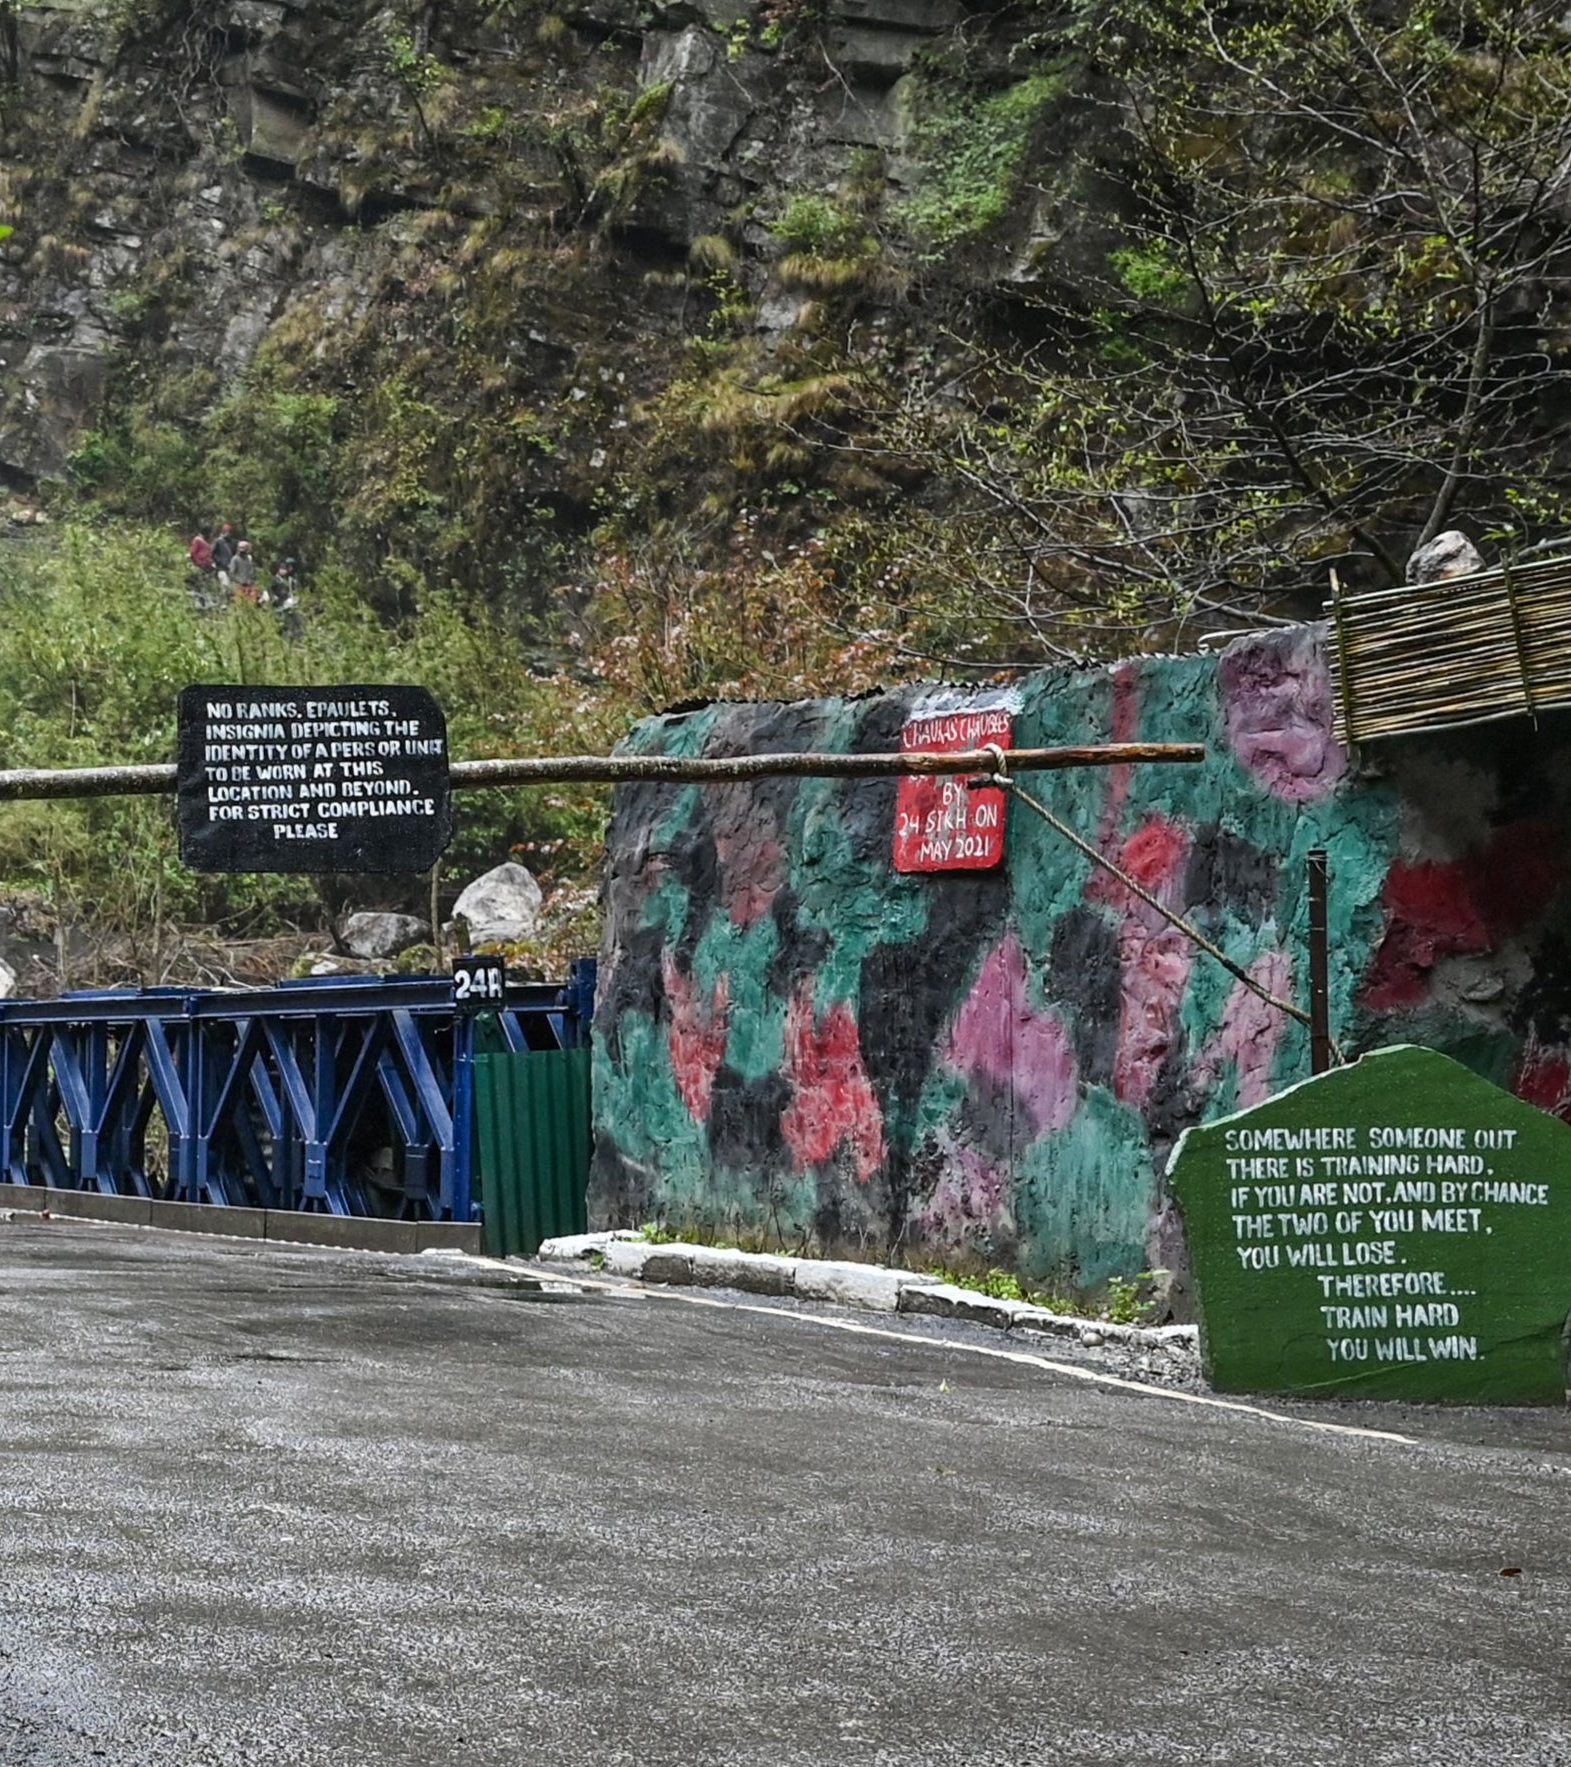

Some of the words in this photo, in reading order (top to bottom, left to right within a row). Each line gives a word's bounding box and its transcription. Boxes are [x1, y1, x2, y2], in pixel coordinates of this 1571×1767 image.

[207, 703, 232, 719] NO
[206, 724, 285, 740] INSIGNIA
[291, 722, 380, 738] DEPICTING
[384, 720, 419, 736] THE
[205, 744, 288, 761] IDENTITY
[292, 744, 308, 759] OF
[315, 743, 329, 759] A
[331, 742, 375, 758] PERS
[378, 741, 401, 757] OR
[206, 766, 228, 782] TO
[232, 766, 250, 781] BE
[257, 764, 306, 780] WORN
[313, 762, 333, 778] AT
[340, 761, 383, 776] THIS
[208, 785, 292, 802] LOCATION
[299, 783, 335, 798] AND
[342, 780, 419, 797] BEYOND.
[943, 782, 962, 805] BY
[209, 806, 244, 821] FOR
[247, 802, 310, 819] STRICT
[317, 799, 434, 816] COMPLIANCE
[899, 813, 919, 836] 24
[926, 807, 967, 833] SIKH
[976, 805, 997, 827] ON
[274, 822, 338, 839] PLEASE
[920, 840, 952, 862] MAY
[957, 838, 989, 857] 2021
[1225, 1128, 1356, 1151] SOMEWHERE
[1369, 1128, 1465, 1149] SOMEONE
[1474, 1129, 1517, 1149] OUT
[1226, 1158, 1289, 1180] THERE
[1296, 1158, 1314, 1178] IS
[1320, 1155, 1420, 1177] TRAINING
[1231, 1186, 1253, 1208] IF
[1255, 1186, 1295, 1207] YOU
[1299, 1184, 1338, 1206] ARE
[1442, 1182, 1465, 1203] BY
[1471, 1182, 1549, 1205] CHANCE
[1232, 1215, 1274, 1238] THE
[1282, 1212, 1328, 1236] TWO
[1335, 1211, 1363, 1234] OF
[1369, 1210, 1414, 1233] YOU
[1237, 1246, 1280, 1270] YOU
[1286, 1244, 1338, 1267] WILL
[1343, 1241, 1407, 1265] LOSE.
[1320, 1305, 1388, 1329] TRAIN
[1396, 1303, 1459, 1327] HARD
[1326, 1338, 1368, 1361] YOU
[1375, 1337, 1427, 1361] WILL
[1427, 1337, 1485, 1360] WIN.
